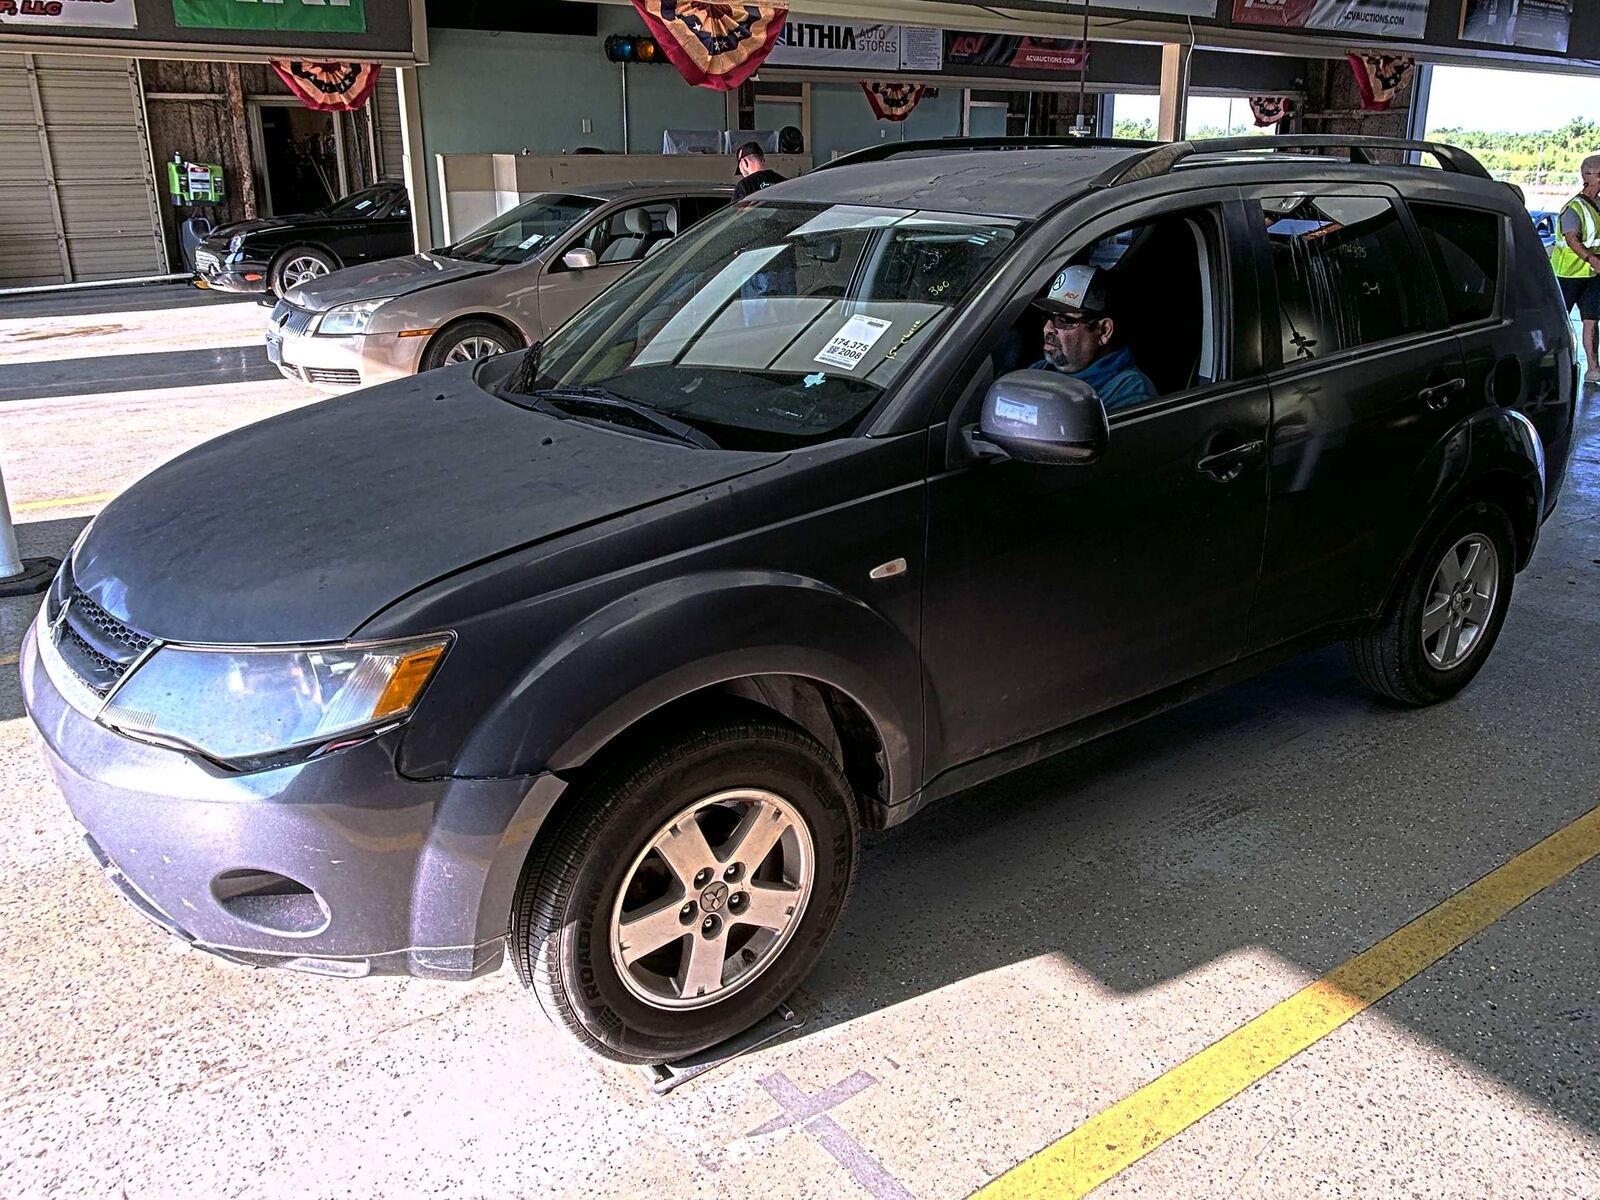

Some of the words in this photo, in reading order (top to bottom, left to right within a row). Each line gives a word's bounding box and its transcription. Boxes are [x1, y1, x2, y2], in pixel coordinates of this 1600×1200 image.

[20, 0, 63, 16] LLC
[787, 22, 856, 50] LITHIA
[859, 28, 886, 41] AUTO
[858, 39, 897, 53] STORES
[1025, 54, 1076, 65] ACVAUCTIONS.COM
[928, 280, 950, 296] 360
[833, 337, 869, 352] 174,375
[838, 348, 863, 360] 2008
